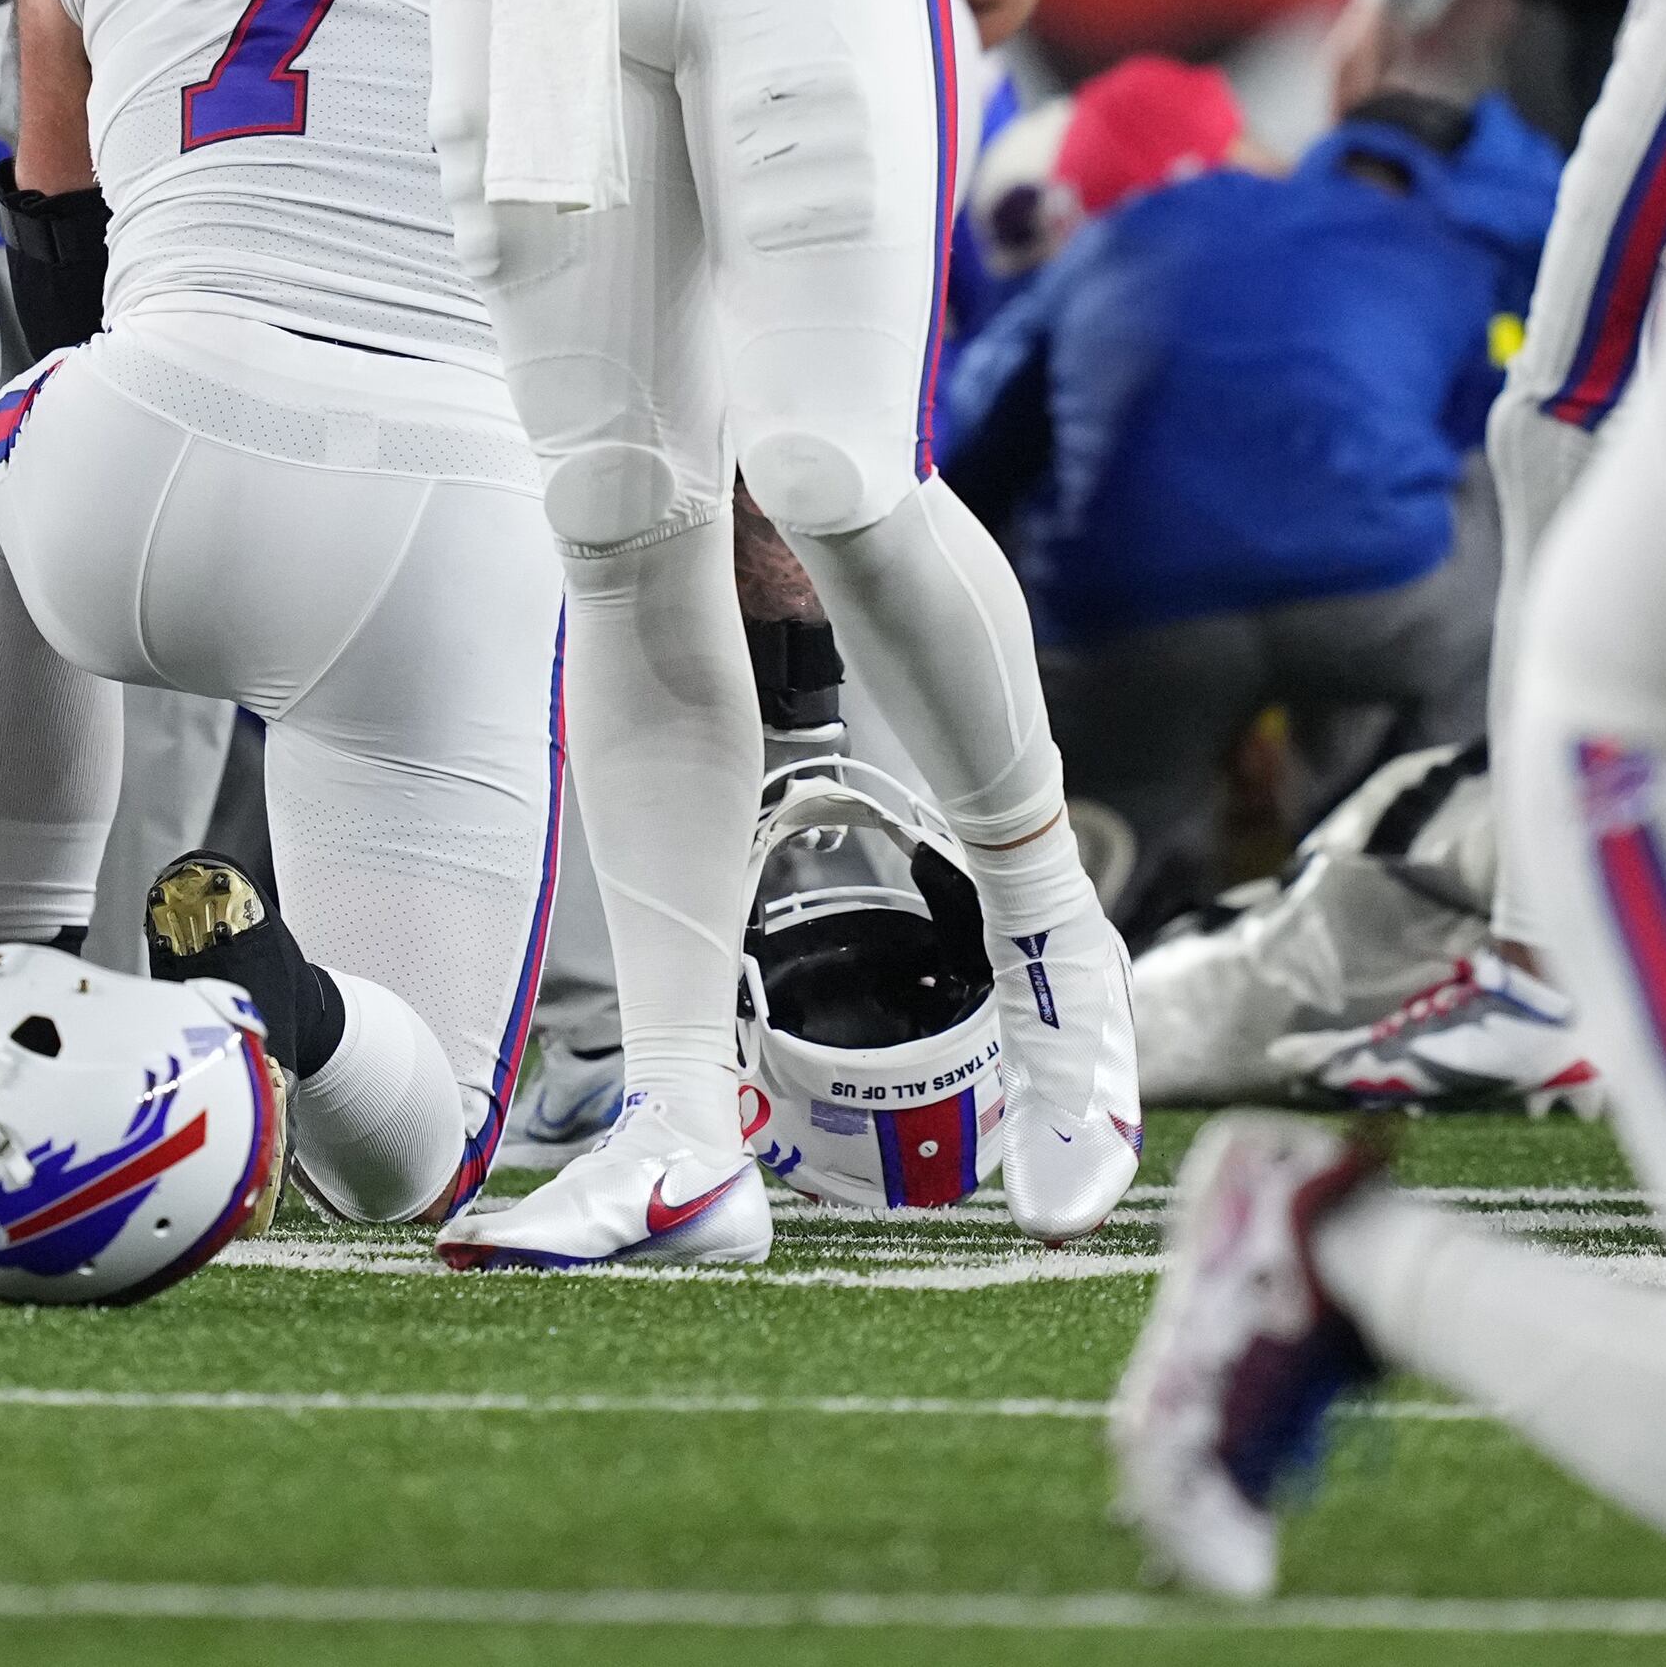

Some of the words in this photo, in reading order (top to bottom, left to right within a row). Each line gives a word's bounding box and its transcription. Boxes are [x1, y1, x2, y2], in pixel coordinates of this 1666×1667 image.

[986, 1040, 1001, 1061] IT
[933, 1055, 985, 1092] TAKES
[831, 1082, 856, 1098] US
[862, 1086, 886, 1100] OF
[892, 1081, 927, 1099] ALL
